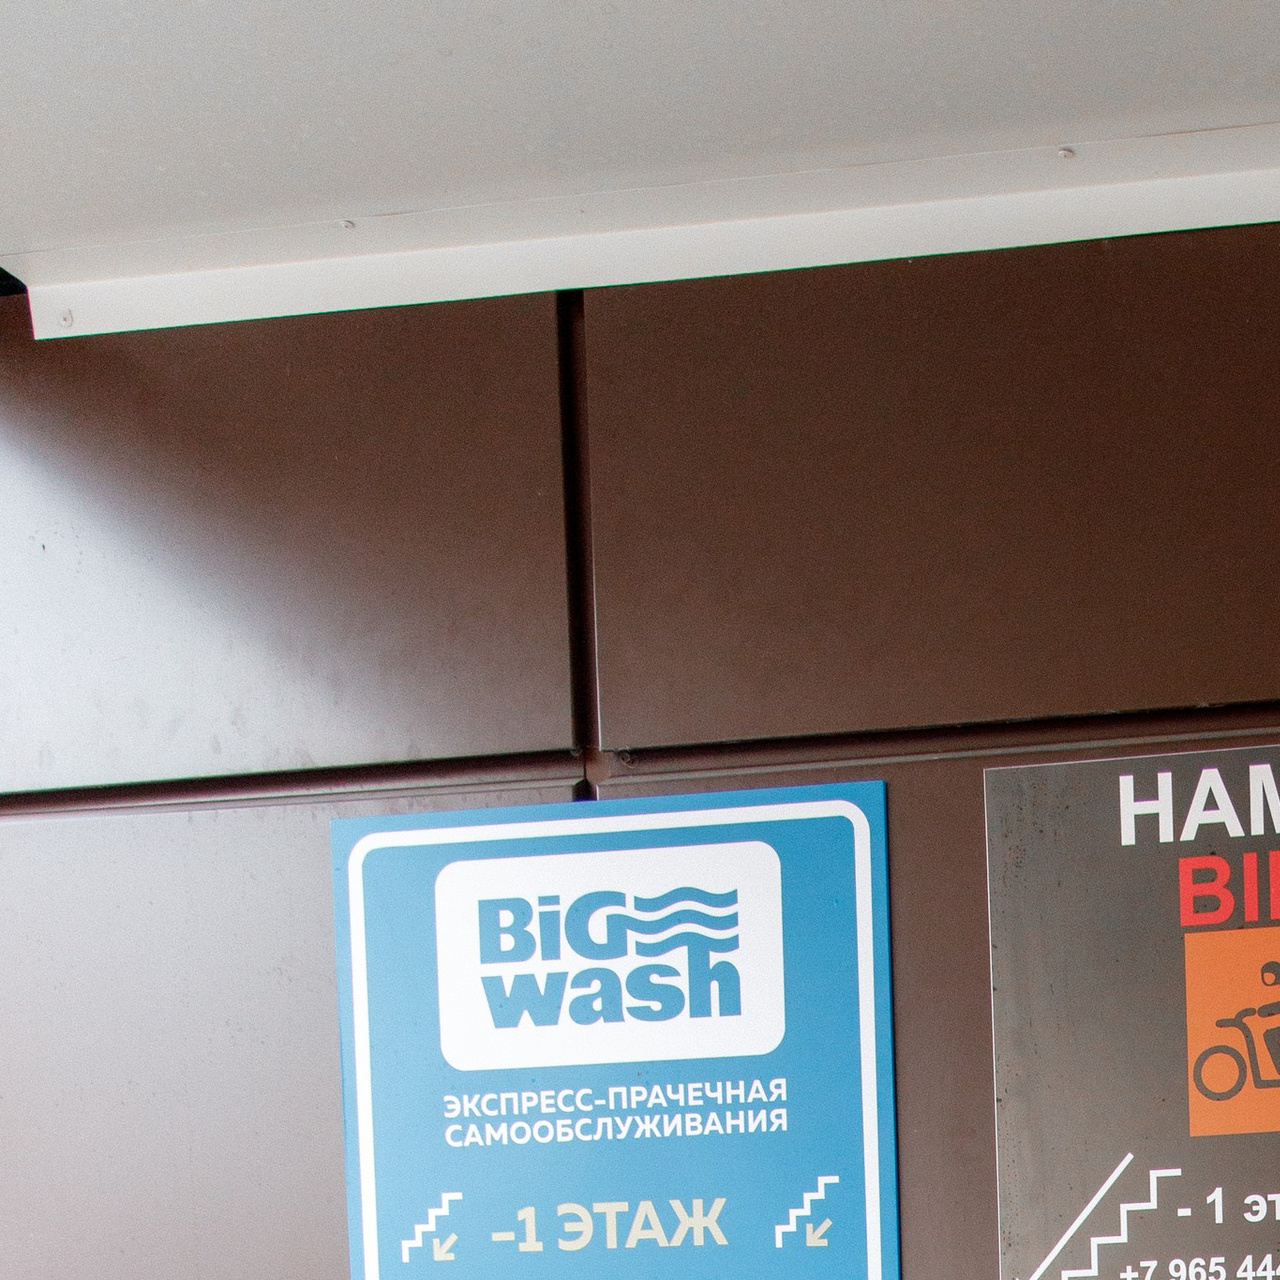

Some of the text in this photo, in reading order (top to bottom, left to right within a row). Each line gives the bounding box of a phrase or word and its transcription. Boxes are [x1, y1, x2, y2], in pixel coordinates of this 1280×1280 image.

[481, 946, 742, 1029] wash
[444, 1078, 787, 1119] ЭКСПРЕСС-ПРАЧЕЧНАЯ
[445, 1108, 788, 1148] САМООБСЛУЖИВАНИЯ
[491, 1198, 729, 1252] -1 ЭТАЖ
